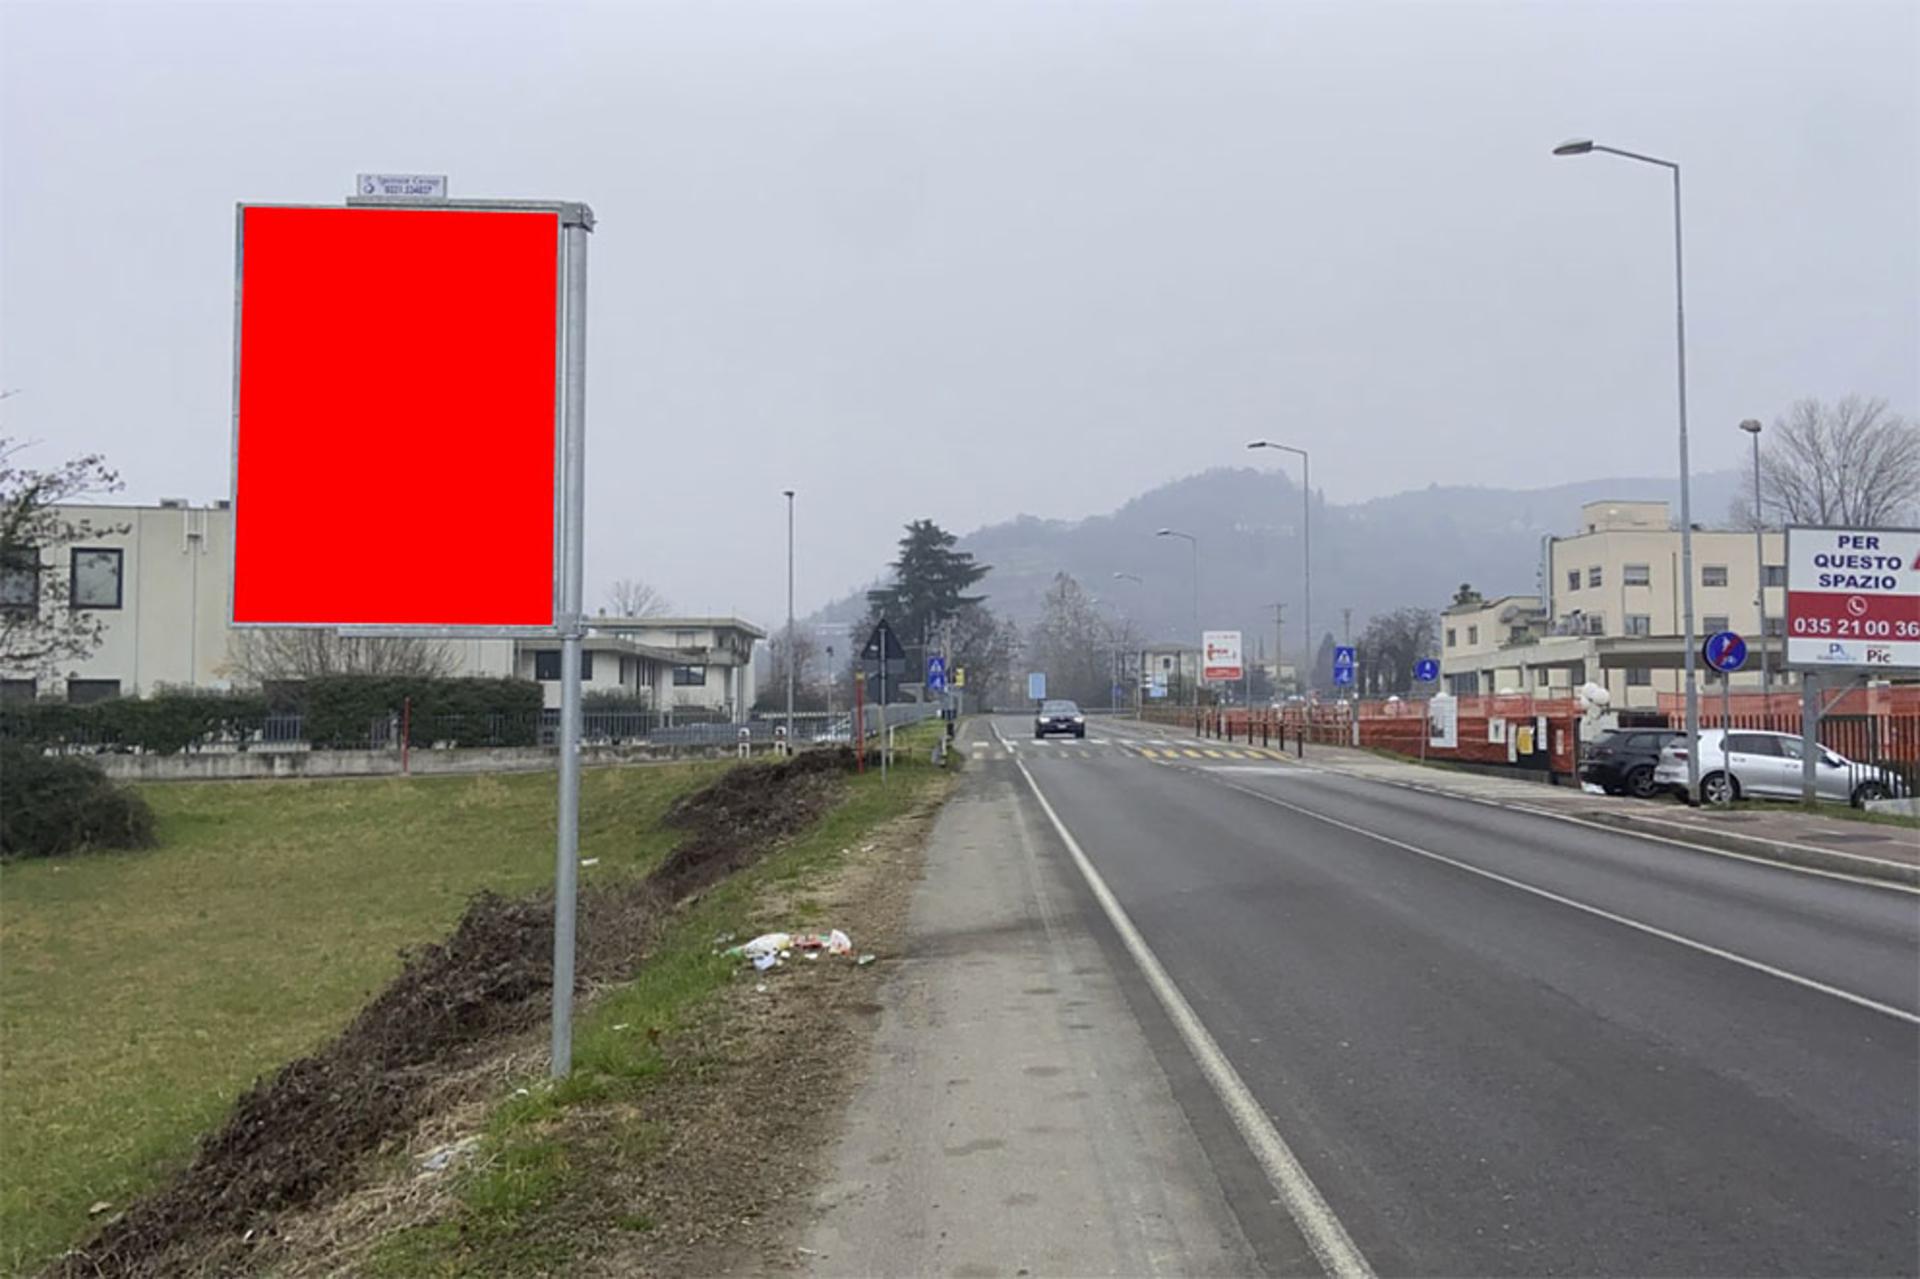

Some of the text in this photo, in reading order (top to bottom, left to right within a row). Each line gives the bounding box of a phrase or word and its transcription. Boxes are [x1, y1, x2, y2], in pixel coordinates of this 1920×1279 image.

[1838, 535, 1880, 550] PER
[1814, 554, 1902, 571] QUESTO
[1818, 573, 1897, 590] SPAZIO
[1794, 617, 1831, 634] 035
[1895, 621, 1920, 636] 36
[1866, 649, 1892, 664] Pic
